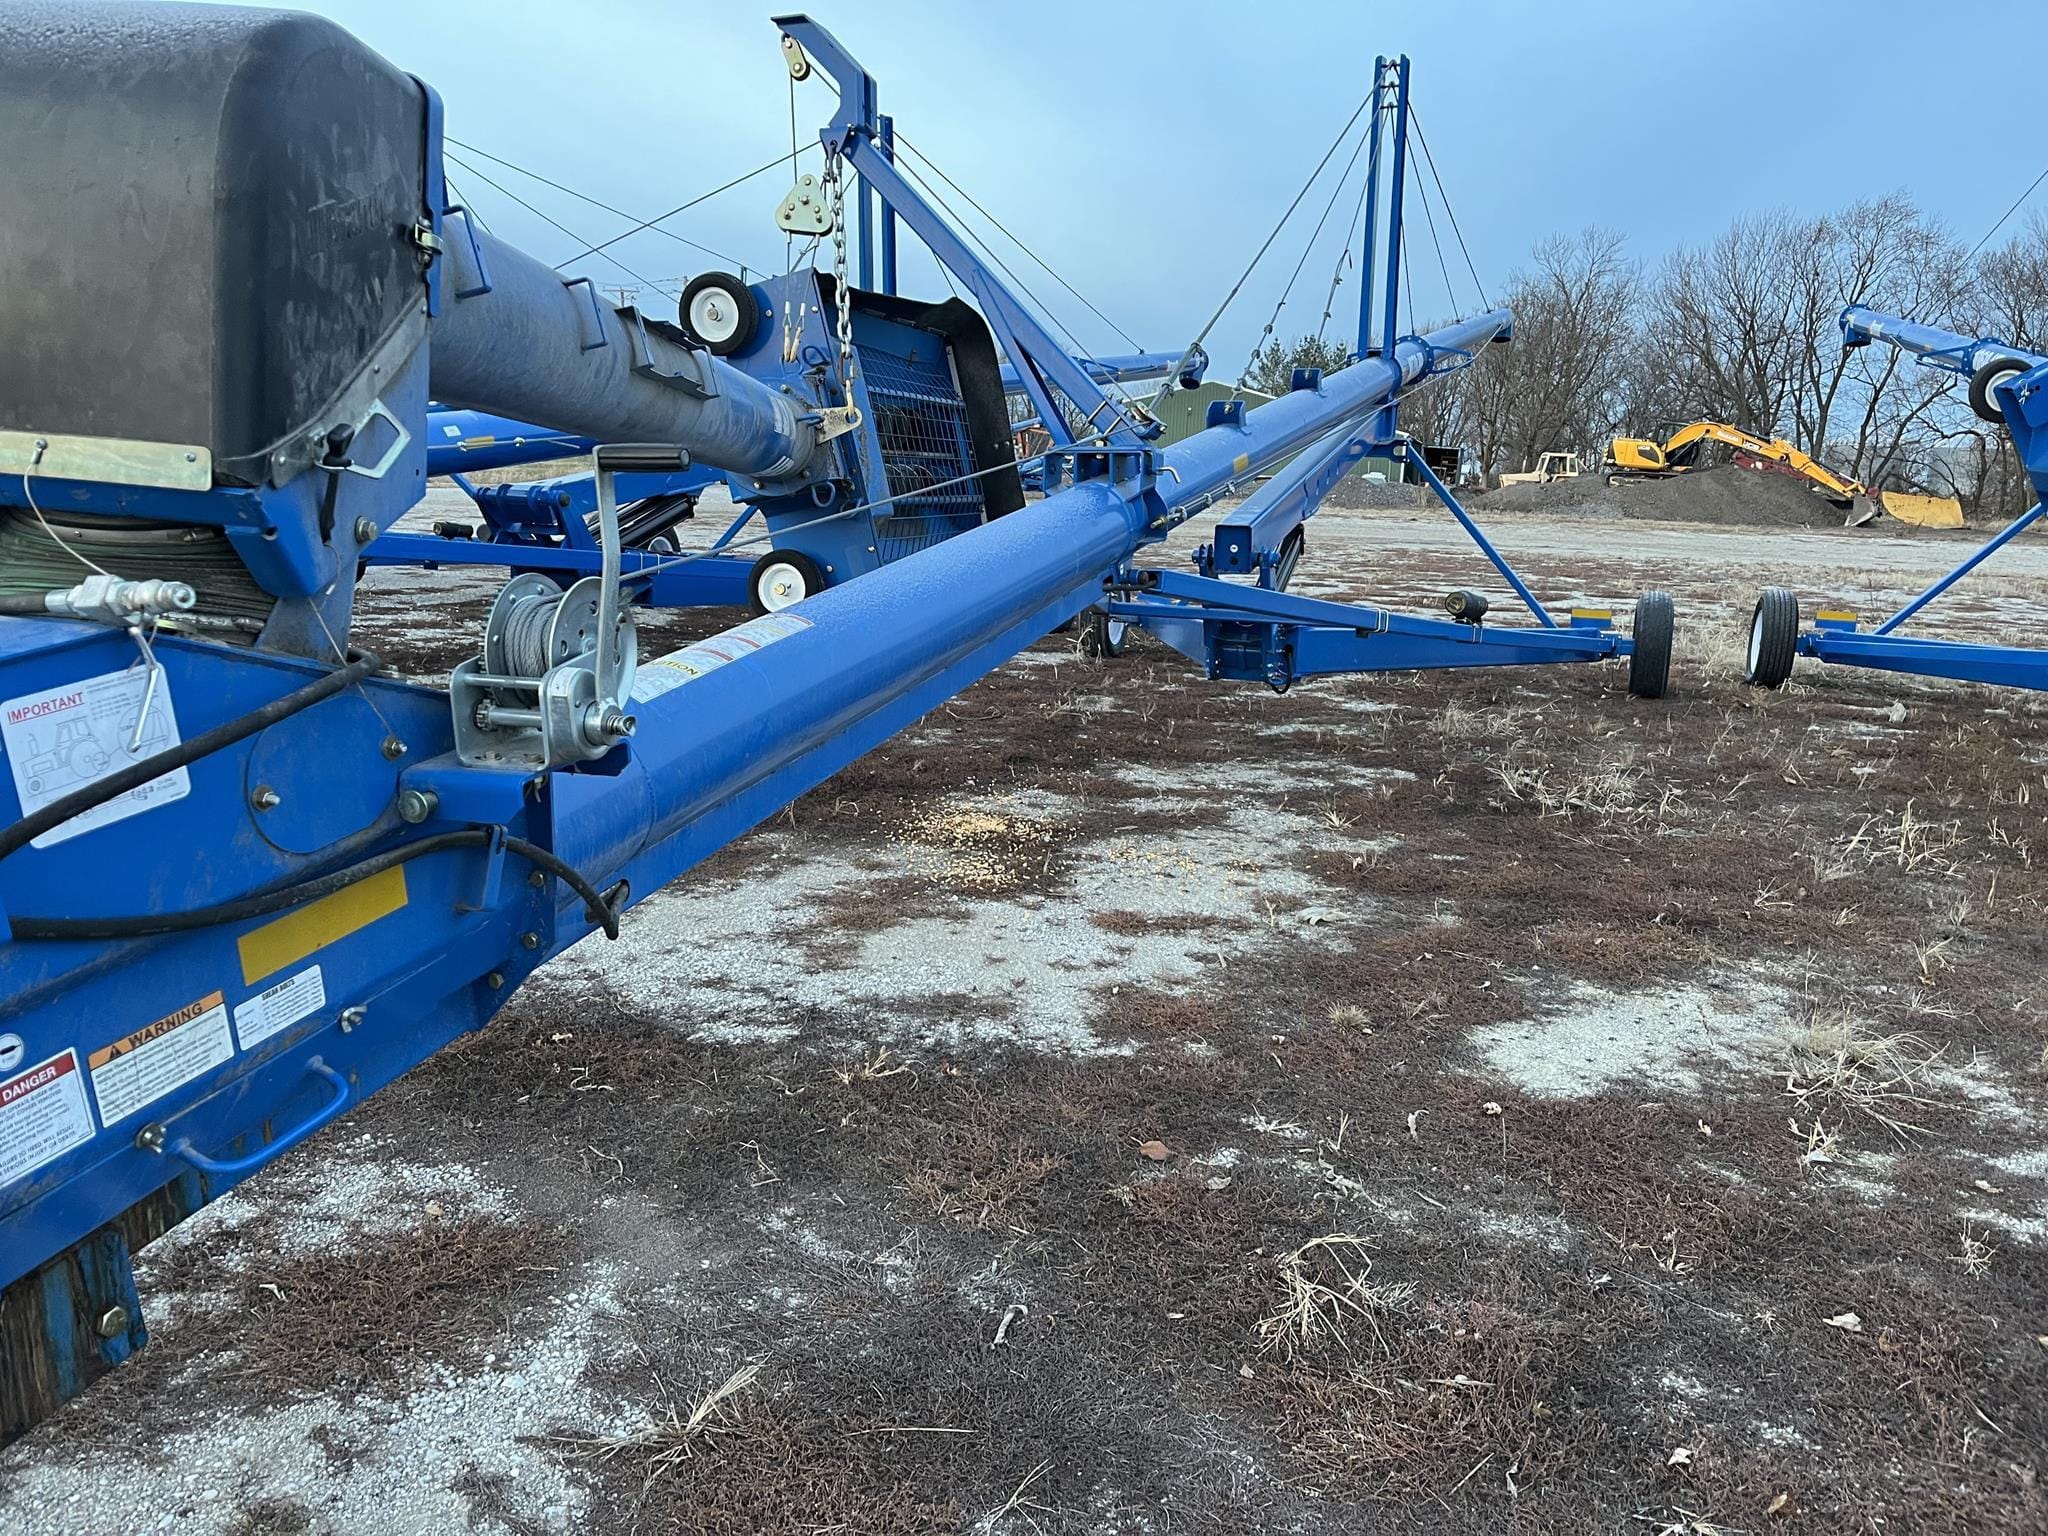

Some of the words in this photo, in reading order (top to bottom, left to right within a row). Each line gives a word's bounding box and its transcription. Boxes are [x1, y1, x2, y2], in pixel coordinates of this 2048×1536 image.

[8, 692, 84, 722] IMPORTANT
[128, 1003, 203, 1048] WARNING
[2, 1066, 56, 1102] DANGER
